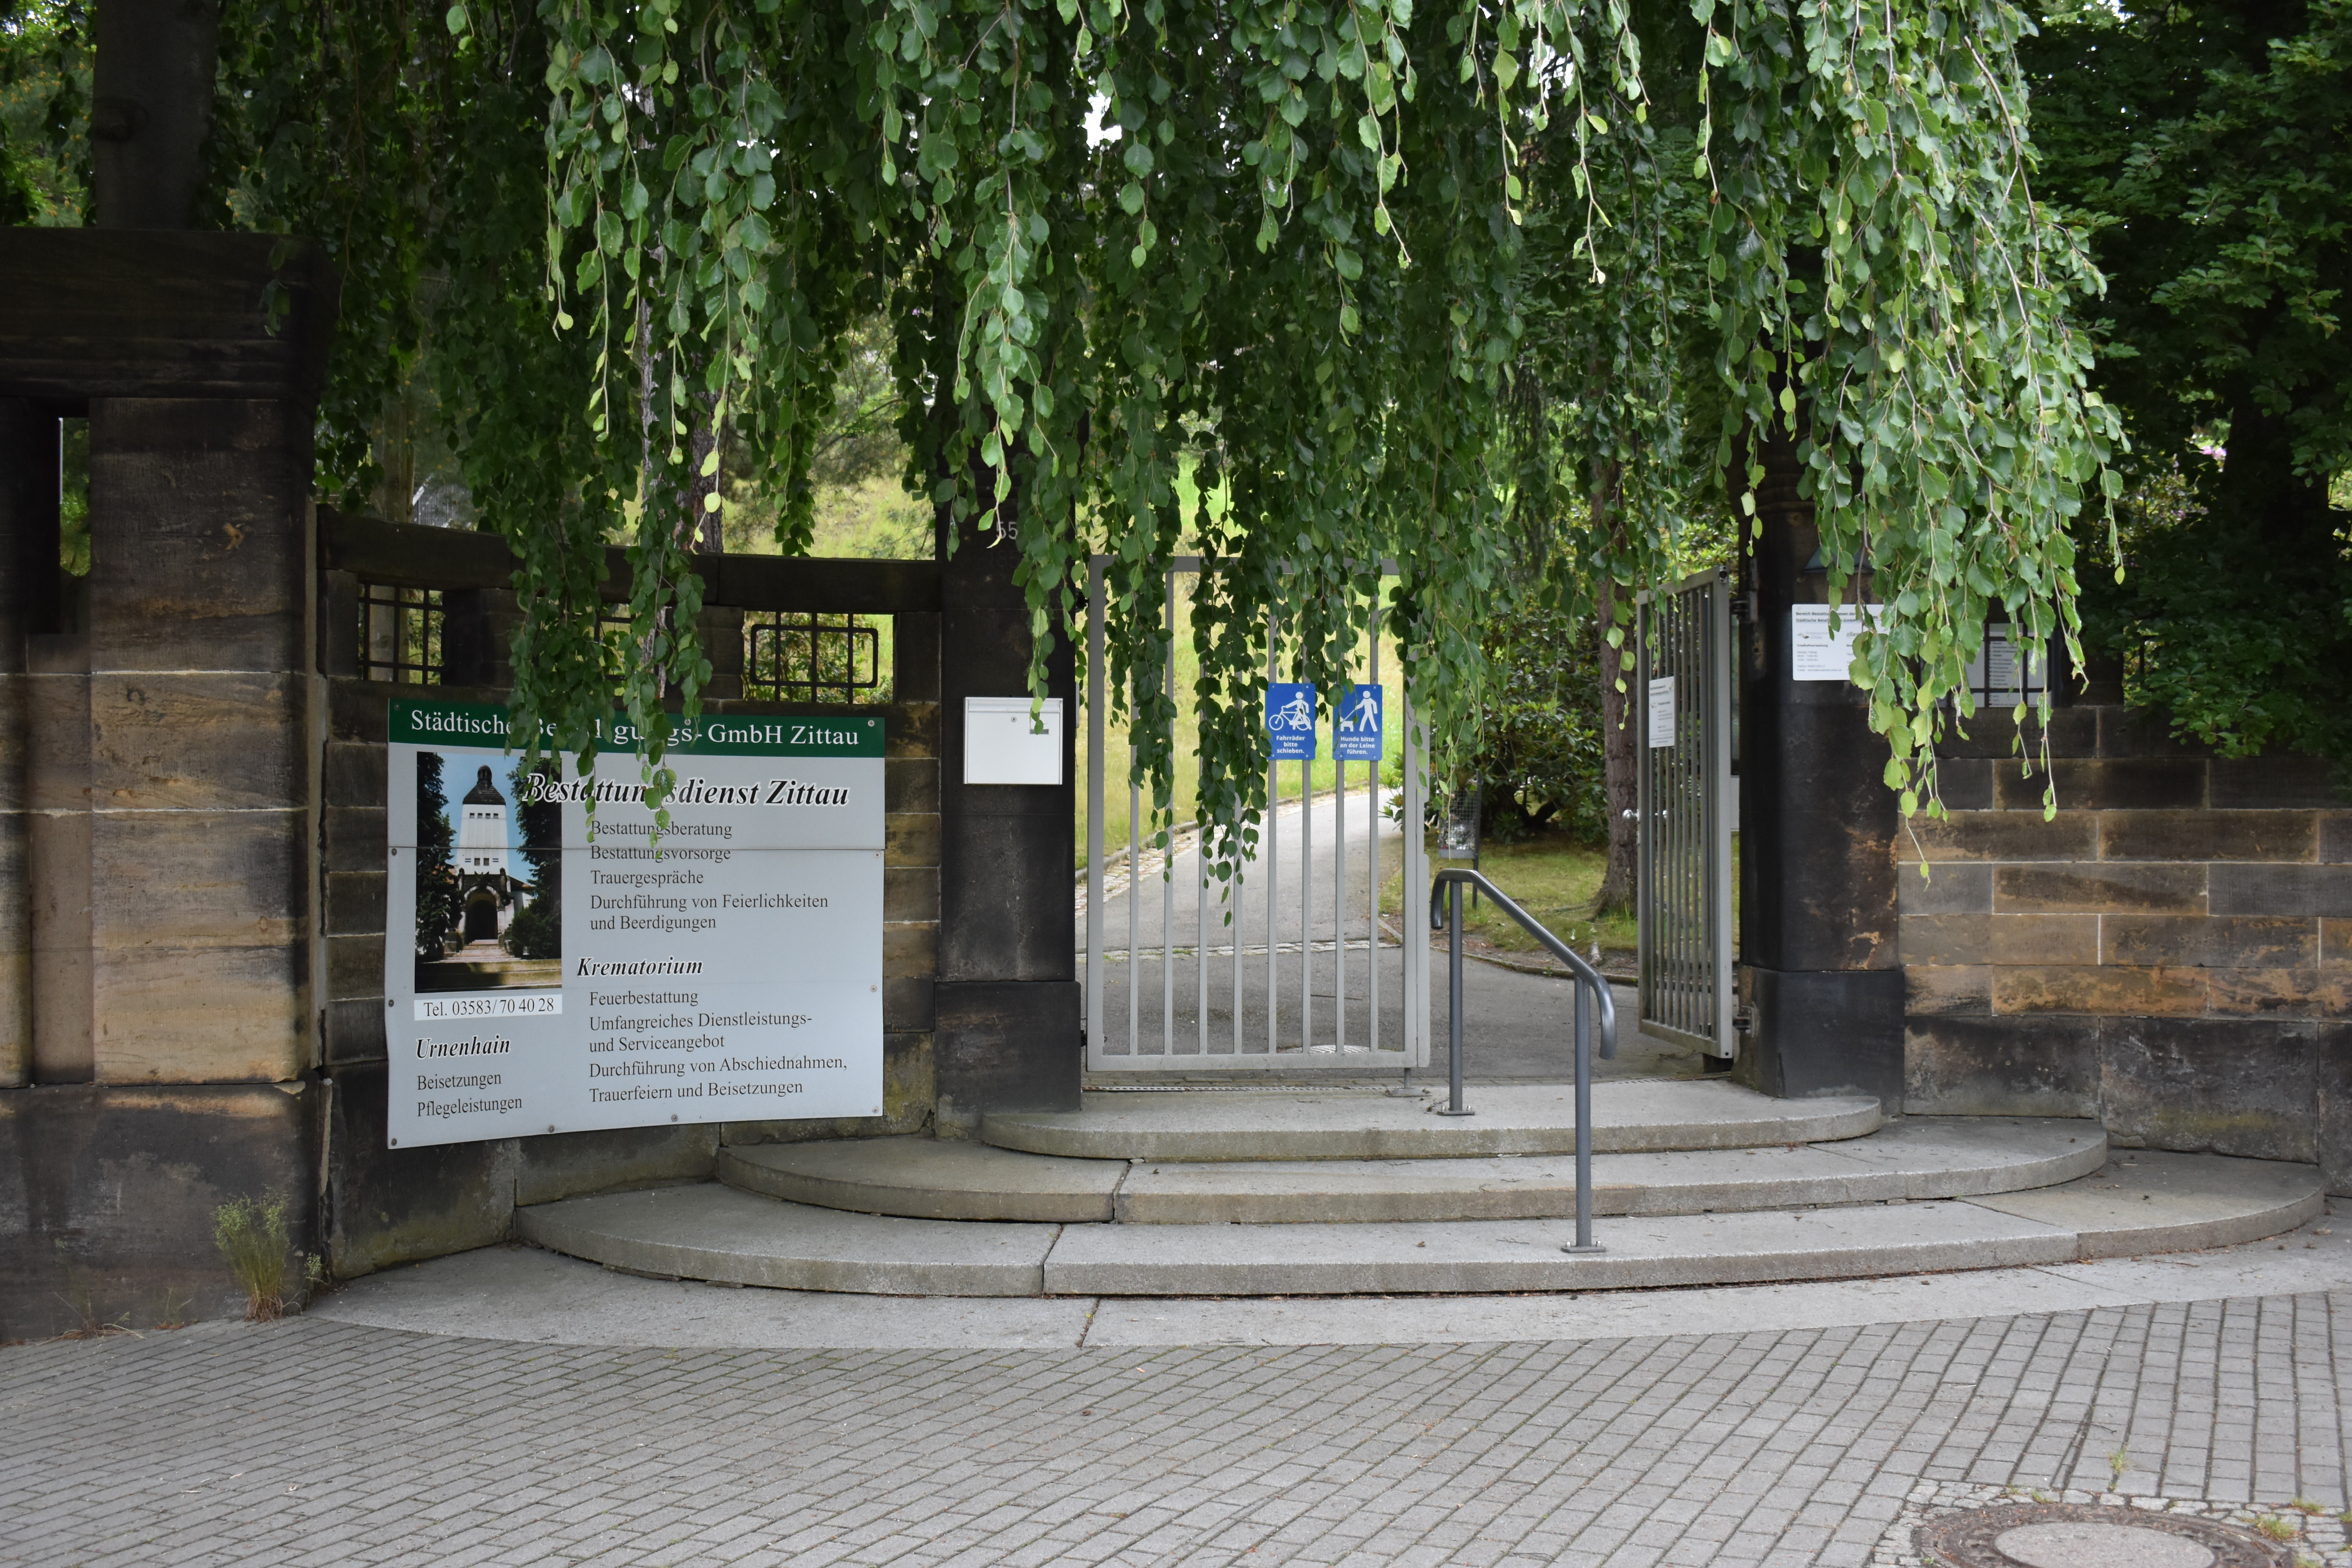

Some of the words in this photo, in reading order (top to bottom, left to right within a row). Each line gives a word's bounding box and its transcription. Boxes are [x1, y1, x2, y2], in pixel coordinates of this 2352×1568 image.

[708, 724, 783, 743] GmbH
[790, 725, 859, 745] Zittau
[523, 773, 760, 810] Bestattunsdienst
[764, 779, 849, 806] Zittau
[592, 820, 732, 839] Bestattungsberatung
[591, 845, 731, 863] Bestattungsvorsorge
[590, 870, 704, 888] Trauergespräche
[591, 894, 687, 912] Durchführung
[691, 898, 717, 908] von
[722, 893, 829, 908] Feierlichkeiten
[590, 915, 615, 930] und
[620, 915, 717, 933] Beerdigungen
[577, 956, 703, 976] Krematorium
[424, 1002, 447, 1016] Tel.
[518, 998, 535, 1013] 40
[538, 997, 554, 1012] 28
[590, 990, 699, 1007] Feuerbestattung
[590, 1013, 693, 1033] Umfangreiches
[698, 1011, 812, 1028] Dienstleistungs-
[416, 1034, 510, 1059] Urnenhain
[589, 1037, 614, 1053] und
[619, 1034, 725, 1052] Serviceangebot
[590, 1060, 685, 1078] Durchführung
[690, 1062, 715, 1073] von
[719, 1055, 847, 1071] Abschiednahmen,
[417, 1074, 501, 1090] Beisetzungen
[589, 1085, 672, 1102] Trauerfeiern
[677, 1082, 703, 1098] und
[708, 1081, 803, 1097] Beisetzungen
[417, 1097, 523, 1119] Pflegeleistungen
